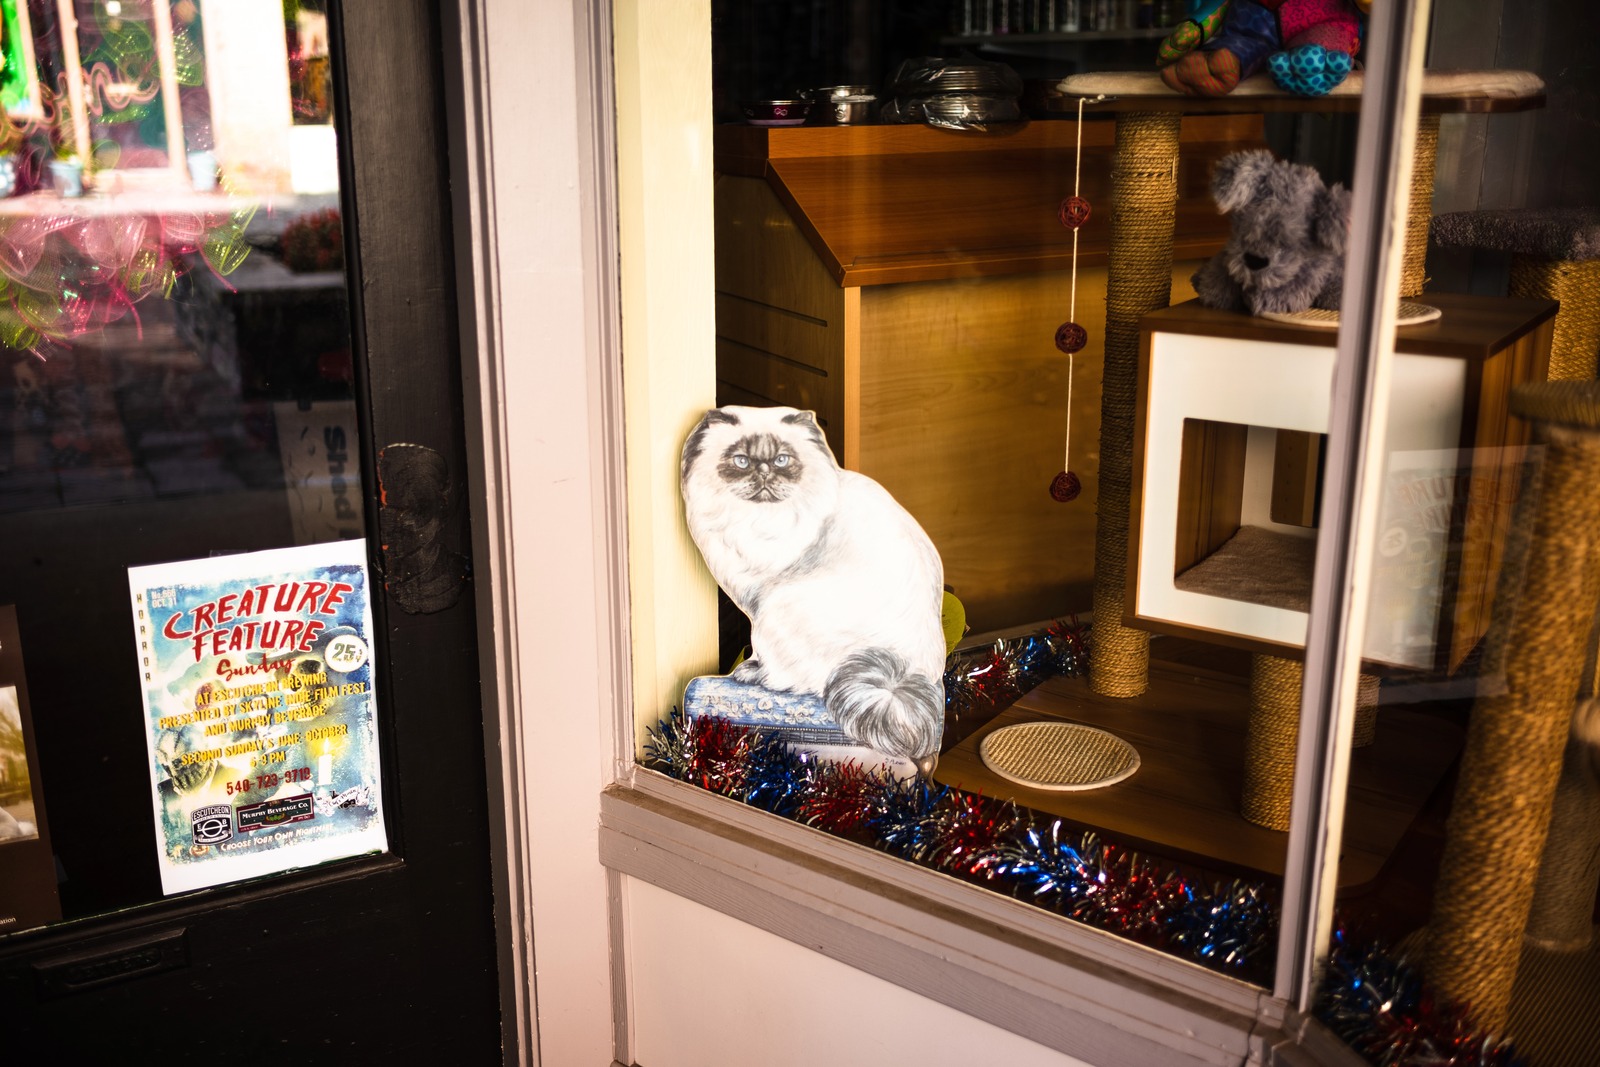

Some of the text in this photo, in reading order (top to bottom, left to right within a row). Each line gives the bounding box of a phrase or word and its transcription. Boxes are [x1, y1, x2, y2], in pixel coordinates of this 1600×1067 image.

[164, 582, 353, 639] CREATURE
[136, 593, 152, 682] HORROR
[192, 620, 325, 663] FEATURE
[216, 653, 296, 682] Sunday
[197, 671, 328, 706] AT ESCUTCHEON BREWING
[159, 682, 367, 730] PRESENTED BY SKYLINE INDIE FILM FEST
[204, 703, 328, 737] AND MURPHY BEVERAGE
[181, 748, 223, 766] SECOND
[269, 751, 286, 764] PM
[193, 806, 230, 820] ESCUTCHEON
